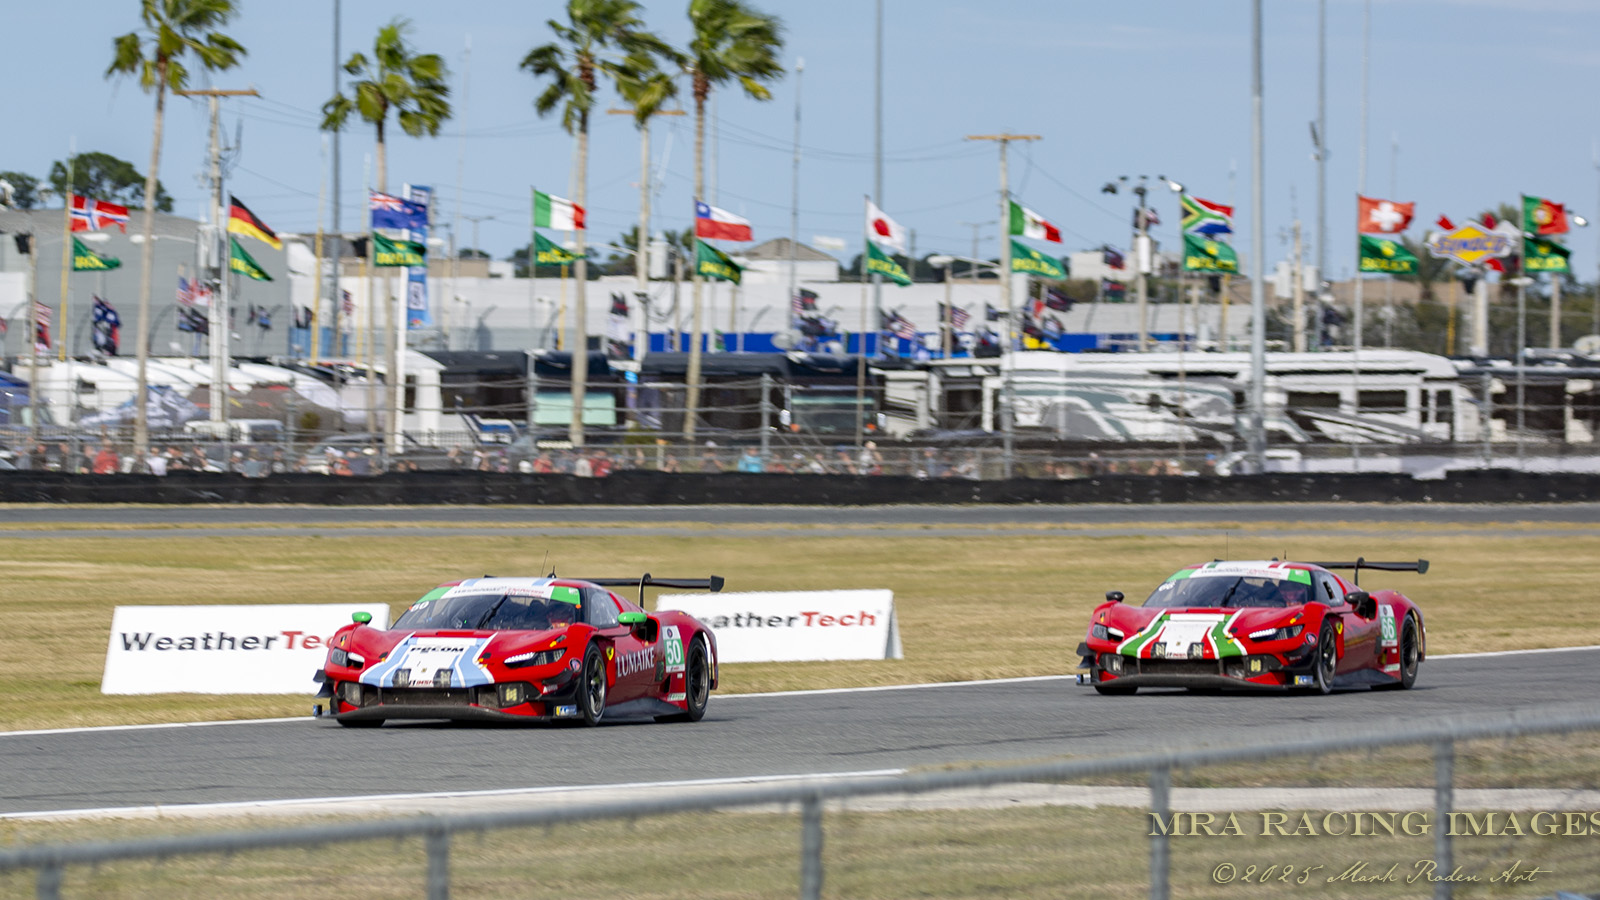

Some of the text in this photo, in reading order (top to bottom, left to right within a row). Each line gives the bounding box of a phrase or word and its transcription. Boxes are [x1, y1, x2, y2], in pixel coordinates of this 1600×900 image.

[1382, 617, 1395, 640] 66
[616, 646, 655, 678] LUMAIKE
[666, 639, 682, 665] 50
